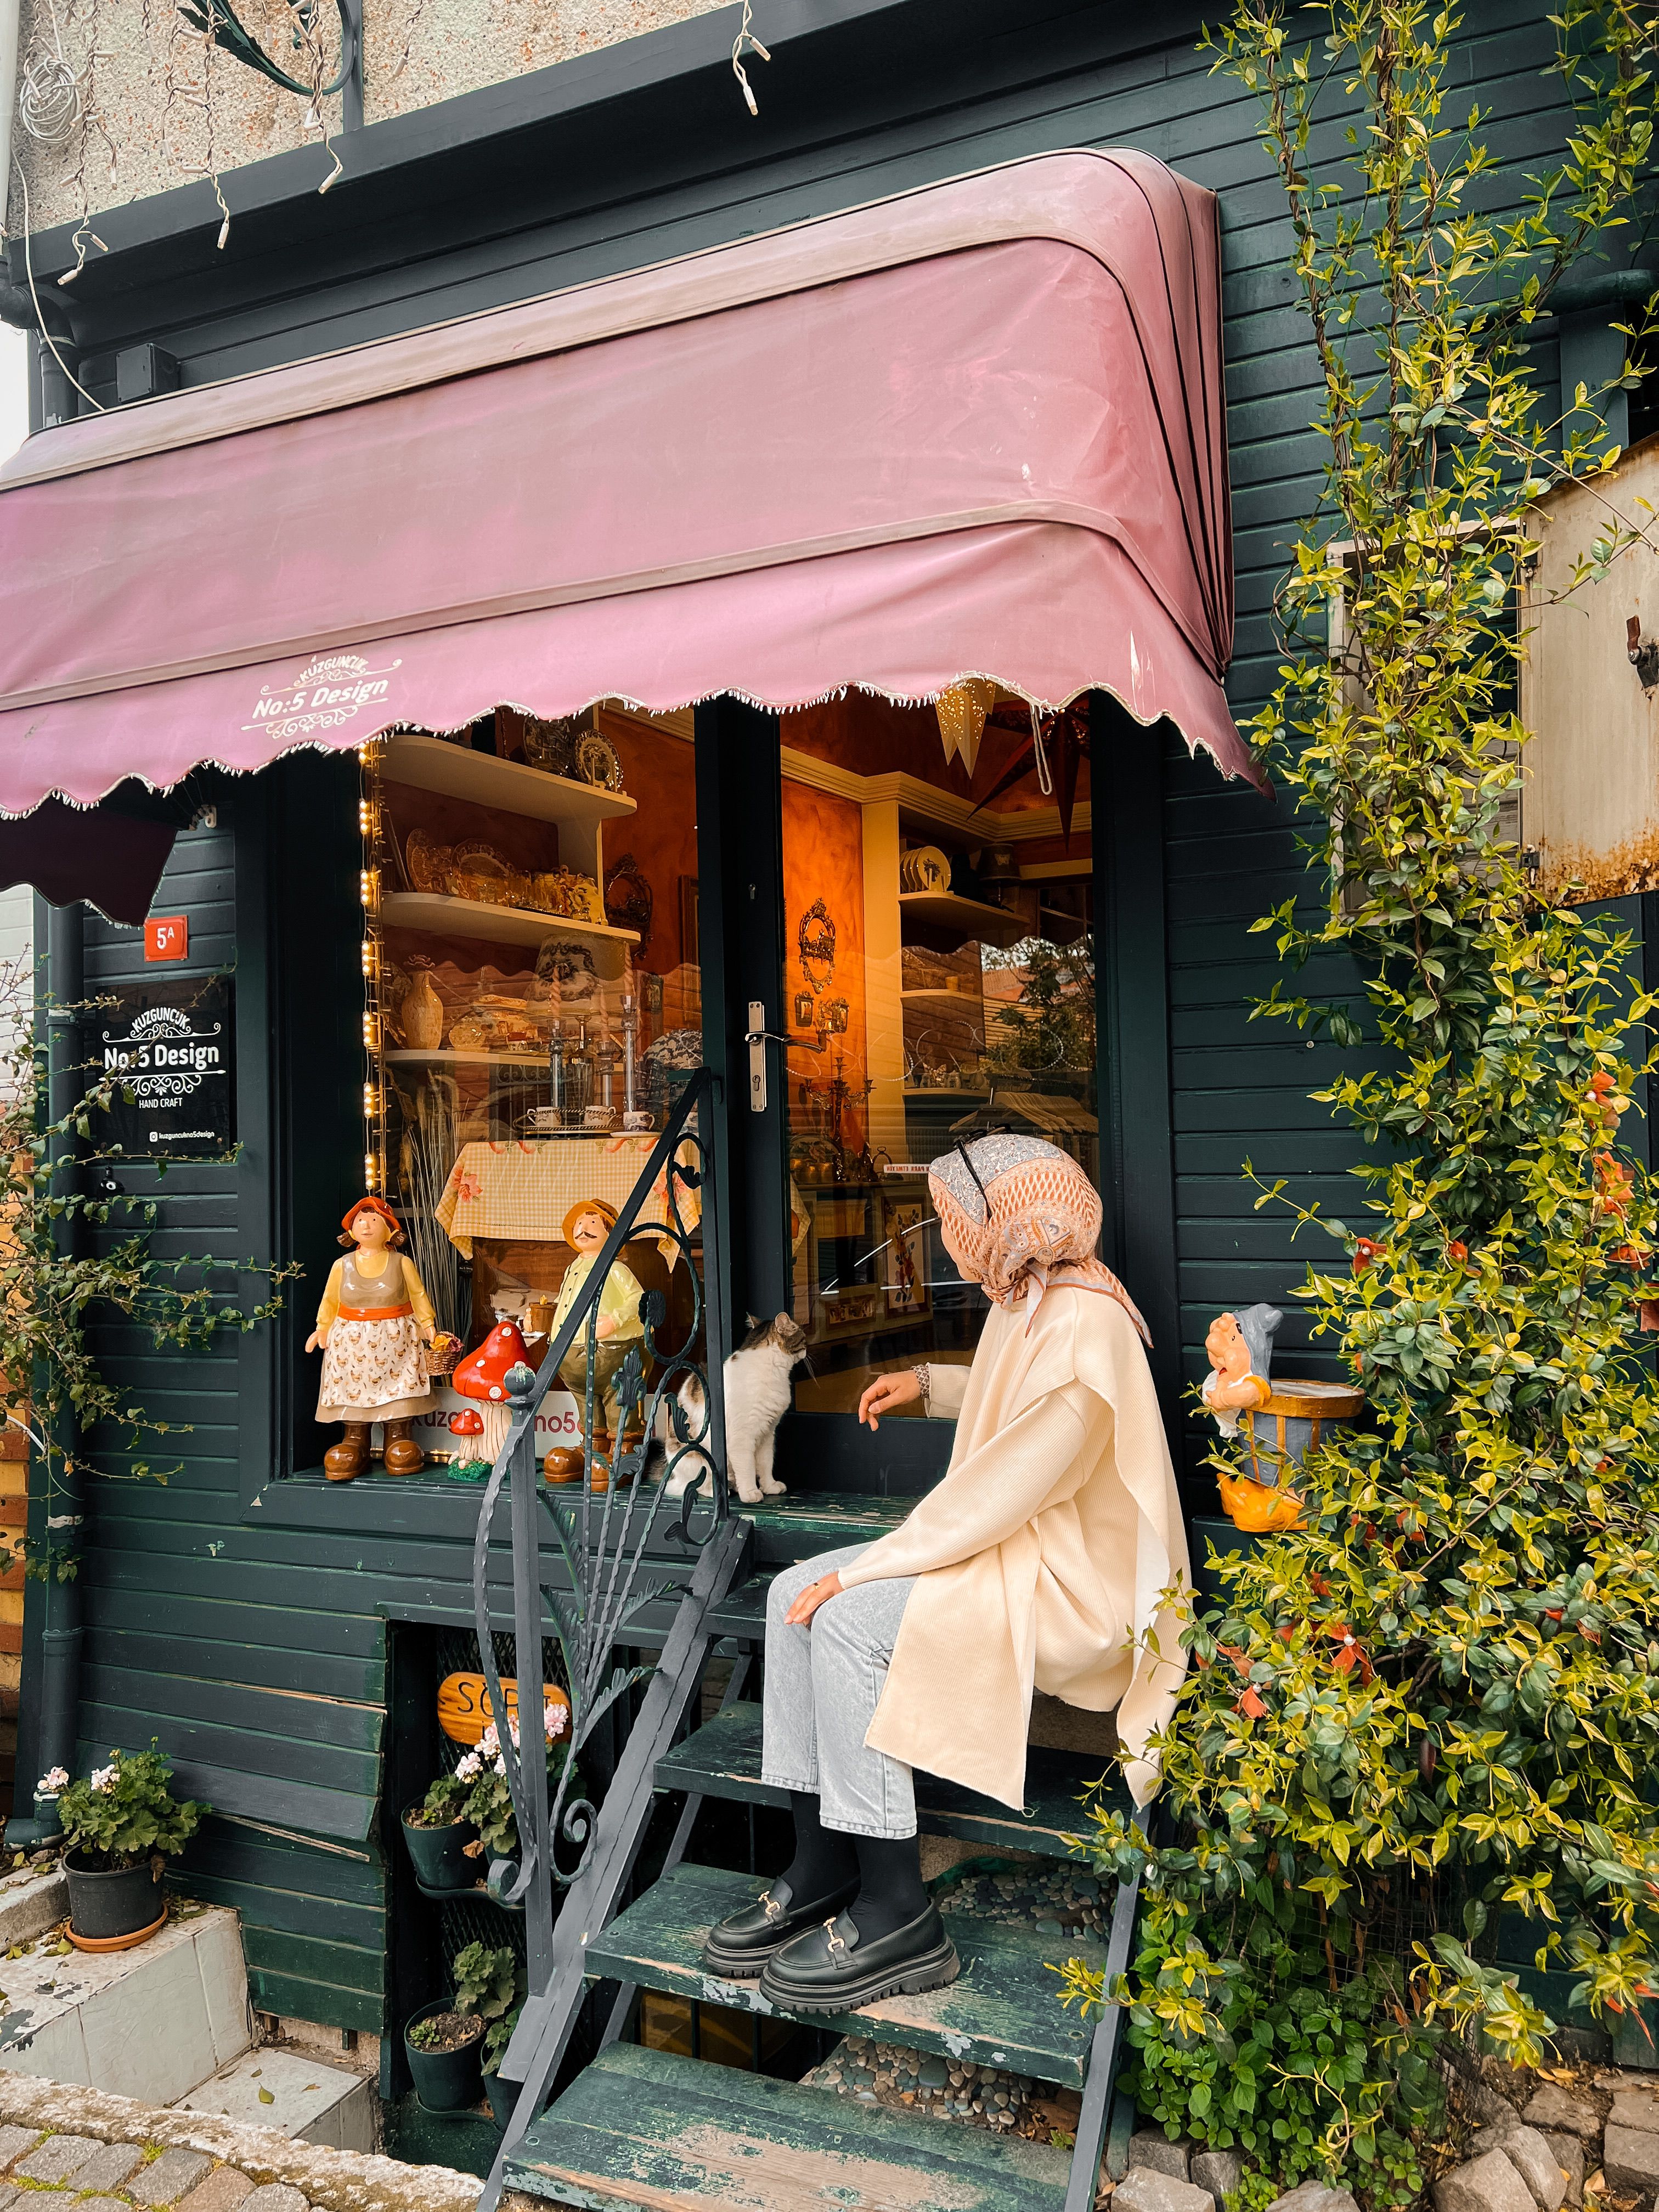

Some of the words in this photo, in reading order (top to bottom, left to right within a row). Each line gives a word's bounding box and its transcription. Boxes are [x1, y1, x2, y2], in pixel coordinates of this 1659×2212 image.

[252, 691, 307, 719] No:5
[311, 679, 389, 707] Design
[132, 1007, 190, 1033] KUZGUNCUK
[155, 1042, 219, 1070] Design
[139, 1099, 159, 1109] HAND
[160, 1097, 183, 1108] CRAFT
